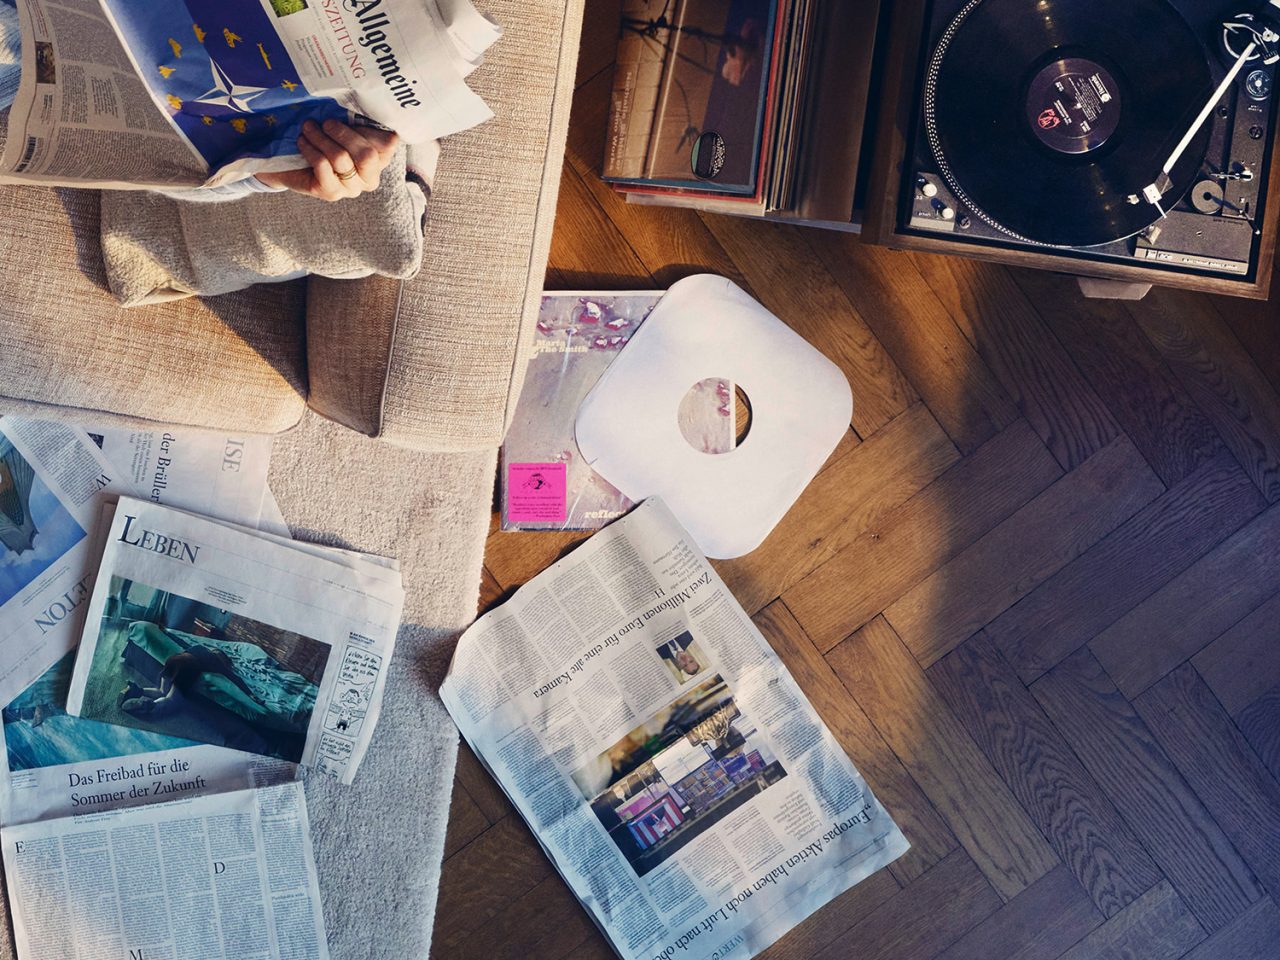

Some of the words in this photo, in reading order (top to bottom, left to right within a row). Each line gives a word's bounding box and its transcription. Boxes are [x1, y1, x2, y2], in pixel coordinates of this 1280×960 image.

[160, 433, 176, 454] der
[221, 438, 244, 472] ISE
[689, 572, 712, 592] Zwei
[642, 592, 691, 620] Millionen
[618, 617, 645, 636] Euro
[584, 644, 603, 661] eine
[604, 634, 620, 648] für
[570, 658, 584, 672] alte
[533, 672, 572, 698] Kamera
[68, 773, 94, 787] Das
[96, 764, 144, 783] Freibad
[148, 762, 166, 776] für
[170, 758, 190, 773] die
[71, 791, 126, 808] Sommer
[129, 784, 150, 799] der
[152, 775, 207, 795] Zukunft
[822, 803, 872, 841] „Europas
[786, 839, 823, 868] Aktien
[214, 862, 226, 874] D
[752, 864, 789, 891] haben
[725, 888, 753, 913] noch
[700, 908, 728, 932] Luft
[674, 926, 701, 950] nach
